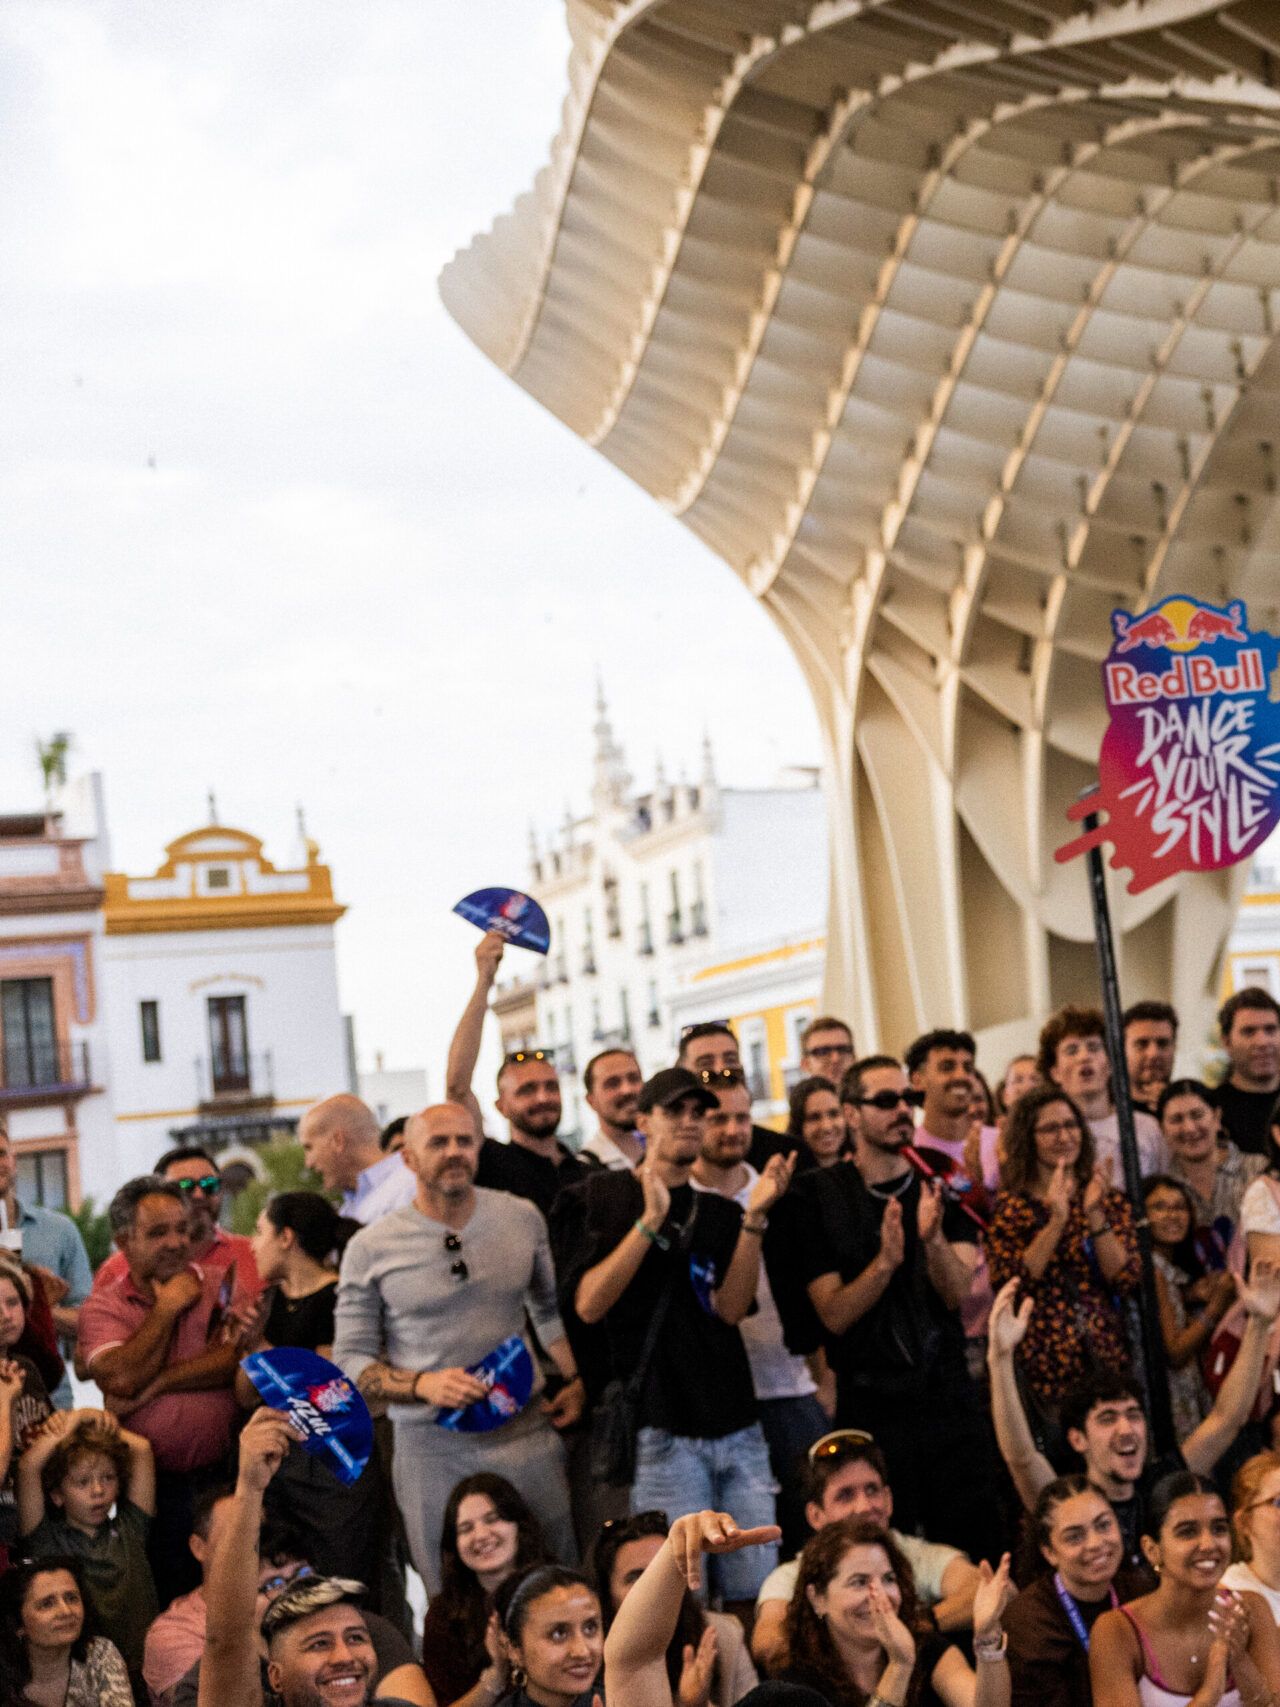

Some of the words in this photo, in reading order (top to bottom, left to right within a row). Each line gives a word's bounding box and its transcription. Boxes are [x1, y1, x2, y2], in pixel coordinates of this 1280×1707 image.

[1107, 656, 1188, 704] Red
[1188, 649, 1266, 697] Bull
[1136, 697, 1256, 767] DANCE
[1152, 735, 1278, 808] YOUR
[1151, 774, 1271, 864] STYLE
[286, 1396, 332, 1436] AZUL
